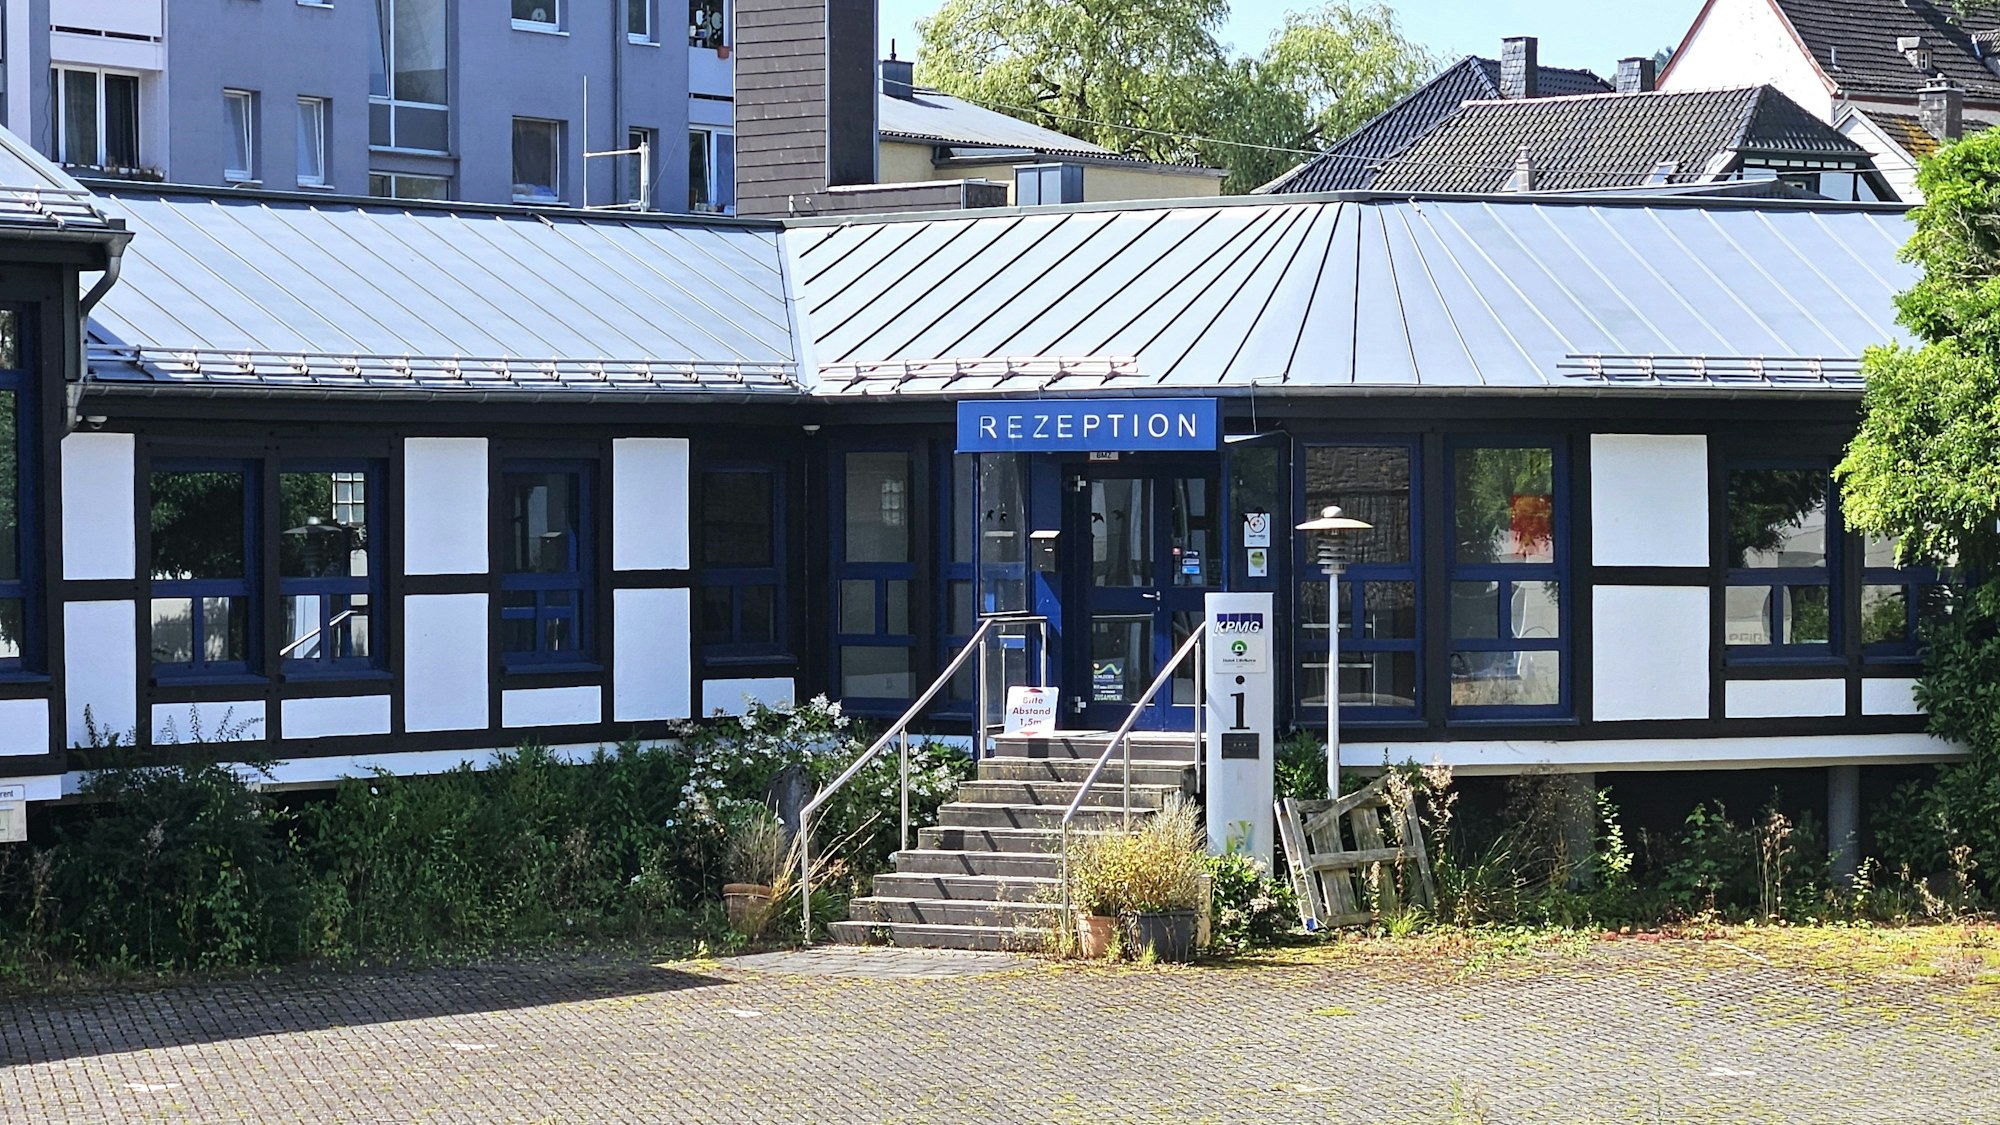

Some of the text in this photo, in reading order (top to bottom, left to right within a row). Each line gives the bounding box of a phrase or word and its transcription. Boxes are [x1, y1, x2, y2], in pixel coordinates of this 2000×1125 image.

[978, 413, 1196, 439] REZEPTION
[1214, 620, 1260, 633] KPMG
[1022, 696, 1044, 705] Bitte
[1012, 707, 1051, 716] Abstand
[1020, 718, 1042, 727] 1,5m
